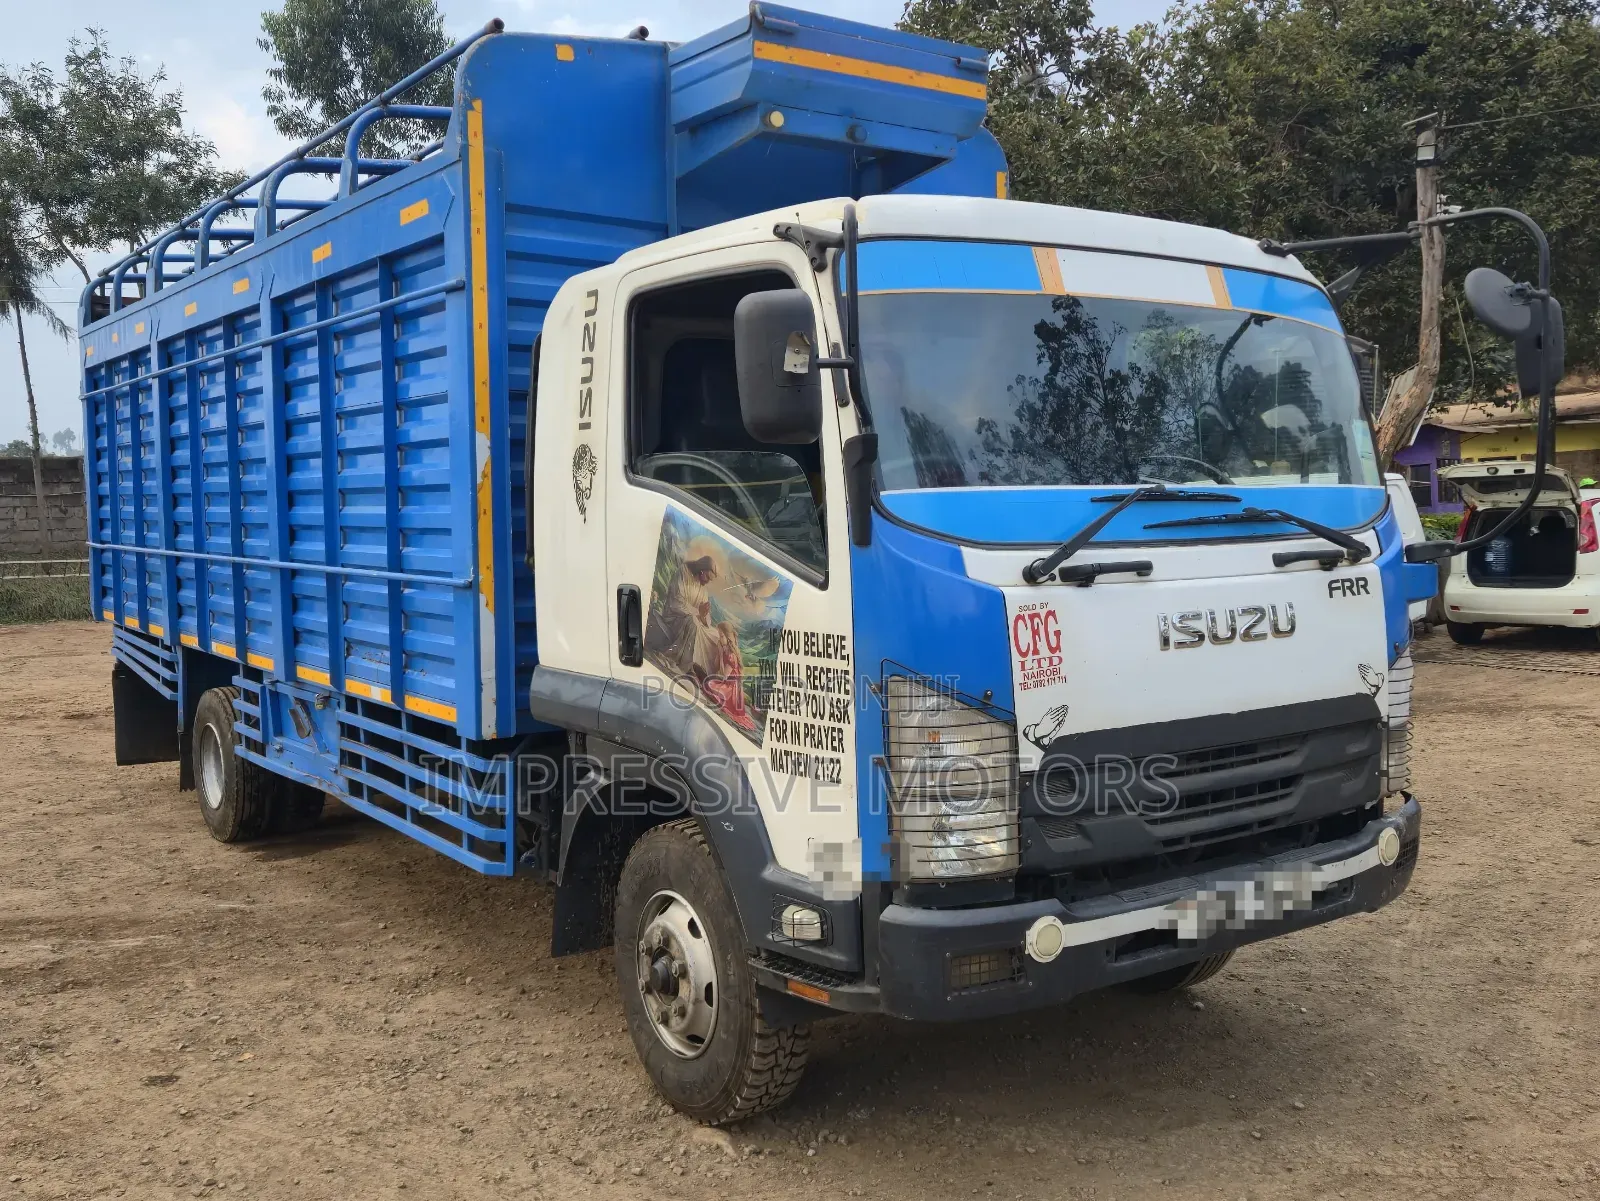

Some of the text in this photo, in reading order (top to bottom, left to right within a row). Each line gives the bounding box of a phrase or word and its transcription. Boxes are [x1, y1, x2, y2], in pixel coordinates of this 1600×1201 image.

[578, 288, 599, 431] ISUZU
[1328, 577, 1370, 599] FRR
[1019, 604, 1036, 612] SOLD
[1013, 609, 1062, 658] CFG
[1156, 602, 1297, 652] ISUZU
[780, 627, 801, 656] YOU
[803, 631, 850, 668] BELIEVE,
[1018, 655, 1063, 671] LTD
[780, 661, 804, 689] WILL
[805, 664, 851, 696] RECEIVE
[1019, 682, 1032, 691] TEL:
[1023, 667, 1061, 681] NAIROBI
[803, 692, 826, 721] YOU
[828, 696, 851, 725] ASK
[769, 717, 845, 754] FOR IN PRAYER
[770, 747, 842, 785] MATHEW 21:22
